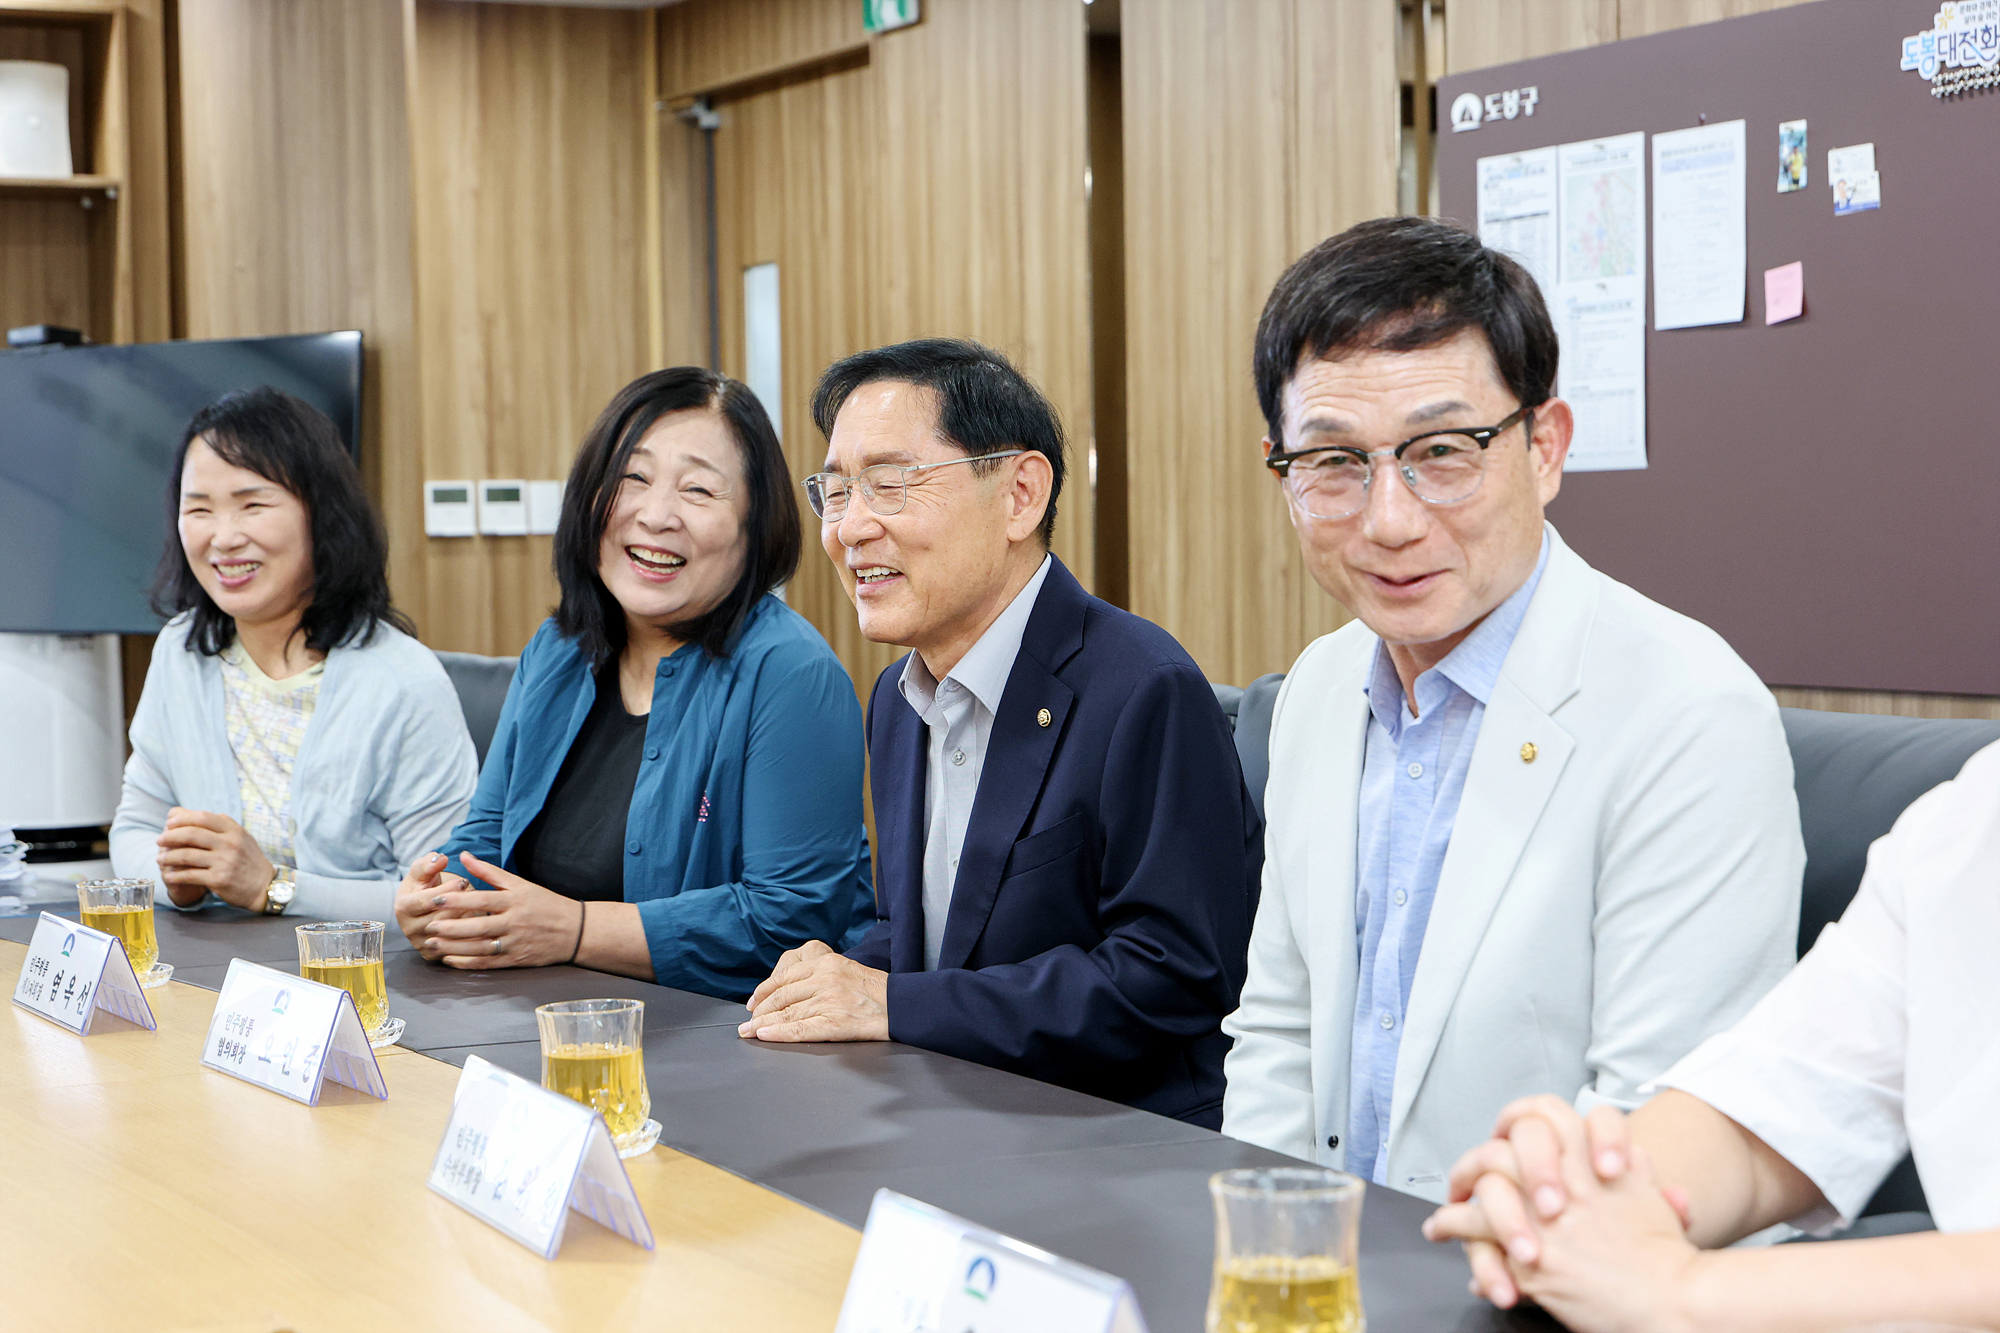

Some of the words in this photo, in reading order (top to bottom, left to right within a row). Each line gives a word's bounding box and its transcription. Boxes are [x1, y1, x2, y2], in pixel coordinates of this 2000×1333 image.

[1484, 86, 1539, 121] 도봉구
[29, 955, 50, 978] 민주평통
[225, 1011, 256, 1038] 민주평통
[217, 1036, 248, 1065] 협의회장
